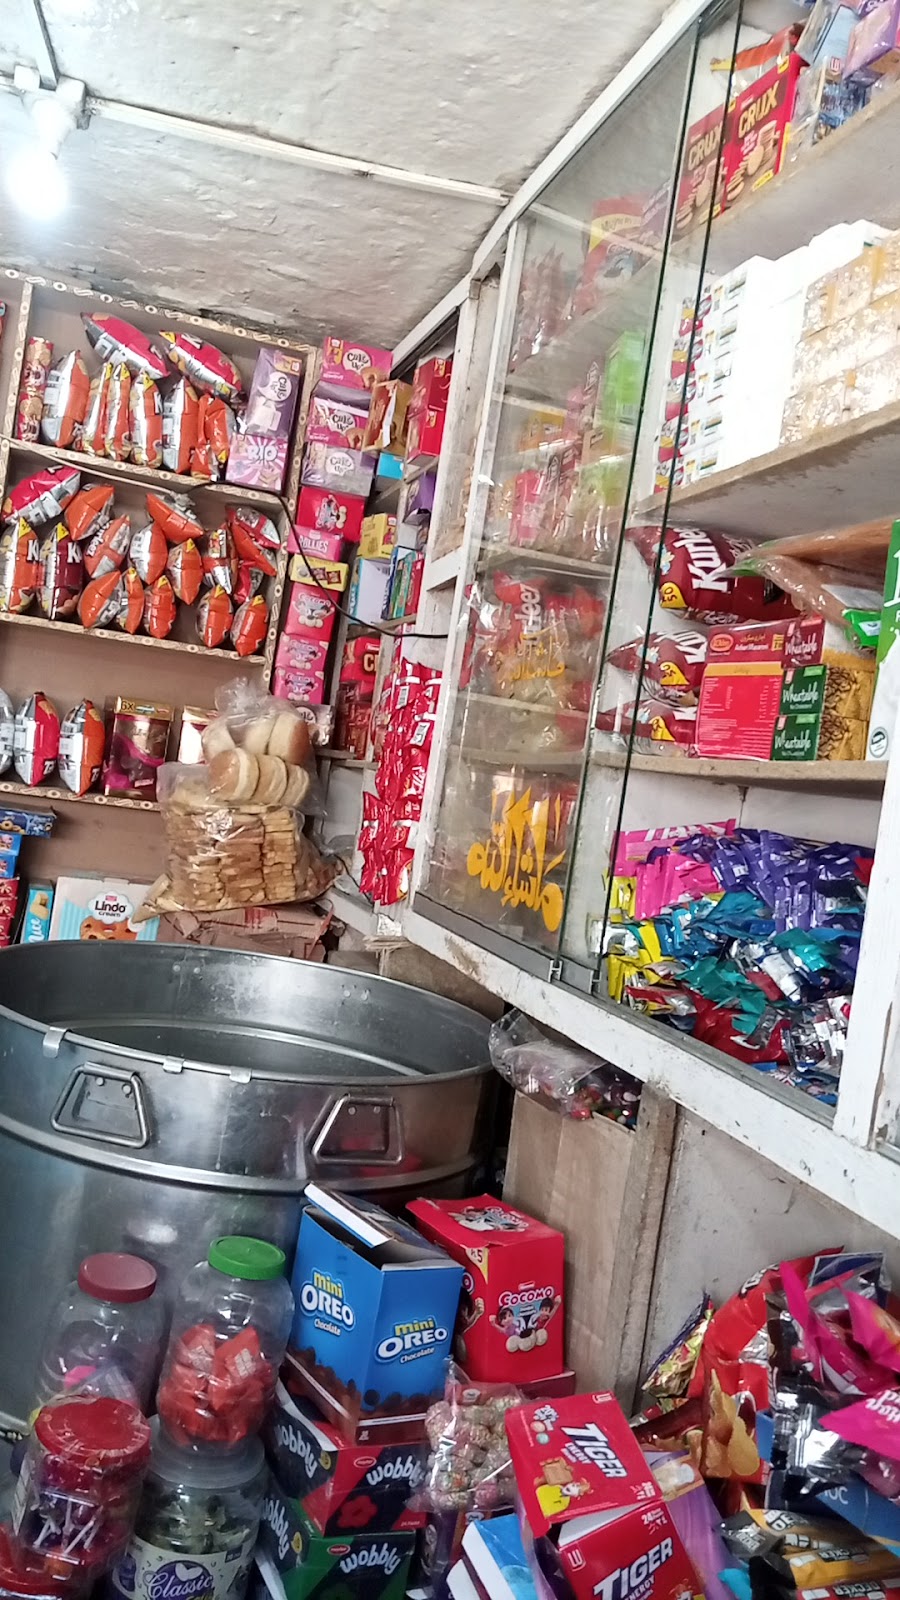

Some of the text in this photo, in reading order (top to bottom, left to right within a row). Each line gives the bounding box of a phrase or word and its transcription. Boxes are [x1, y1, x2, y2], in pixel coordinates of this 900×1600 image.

[738, 80, 780, 139] CRUX
[688, 121, 723, 170] CRUX
[247, 444, 278, 461] RIO
[782, 681, 819, 704] Wheatable
[94, 900, 126, 913] Lindo
[314, 1272, 343, 1299] mini
[499, 1286, 554, 1307] COCOMO
[301, 1285, 354, 1326] OREO
[314, 1318, 341, 1336] Chocolate
[395, 1318, 434, 1336] mini
[378, 1328, 448, 1358] OREO
[400, 1347, 435, 1364] Chocolate
[561, 1423, 628, 1478] TIGER
[340, 1543, 401, 1575] wobbly
[593, 1537, 674, 1600] TIGER
